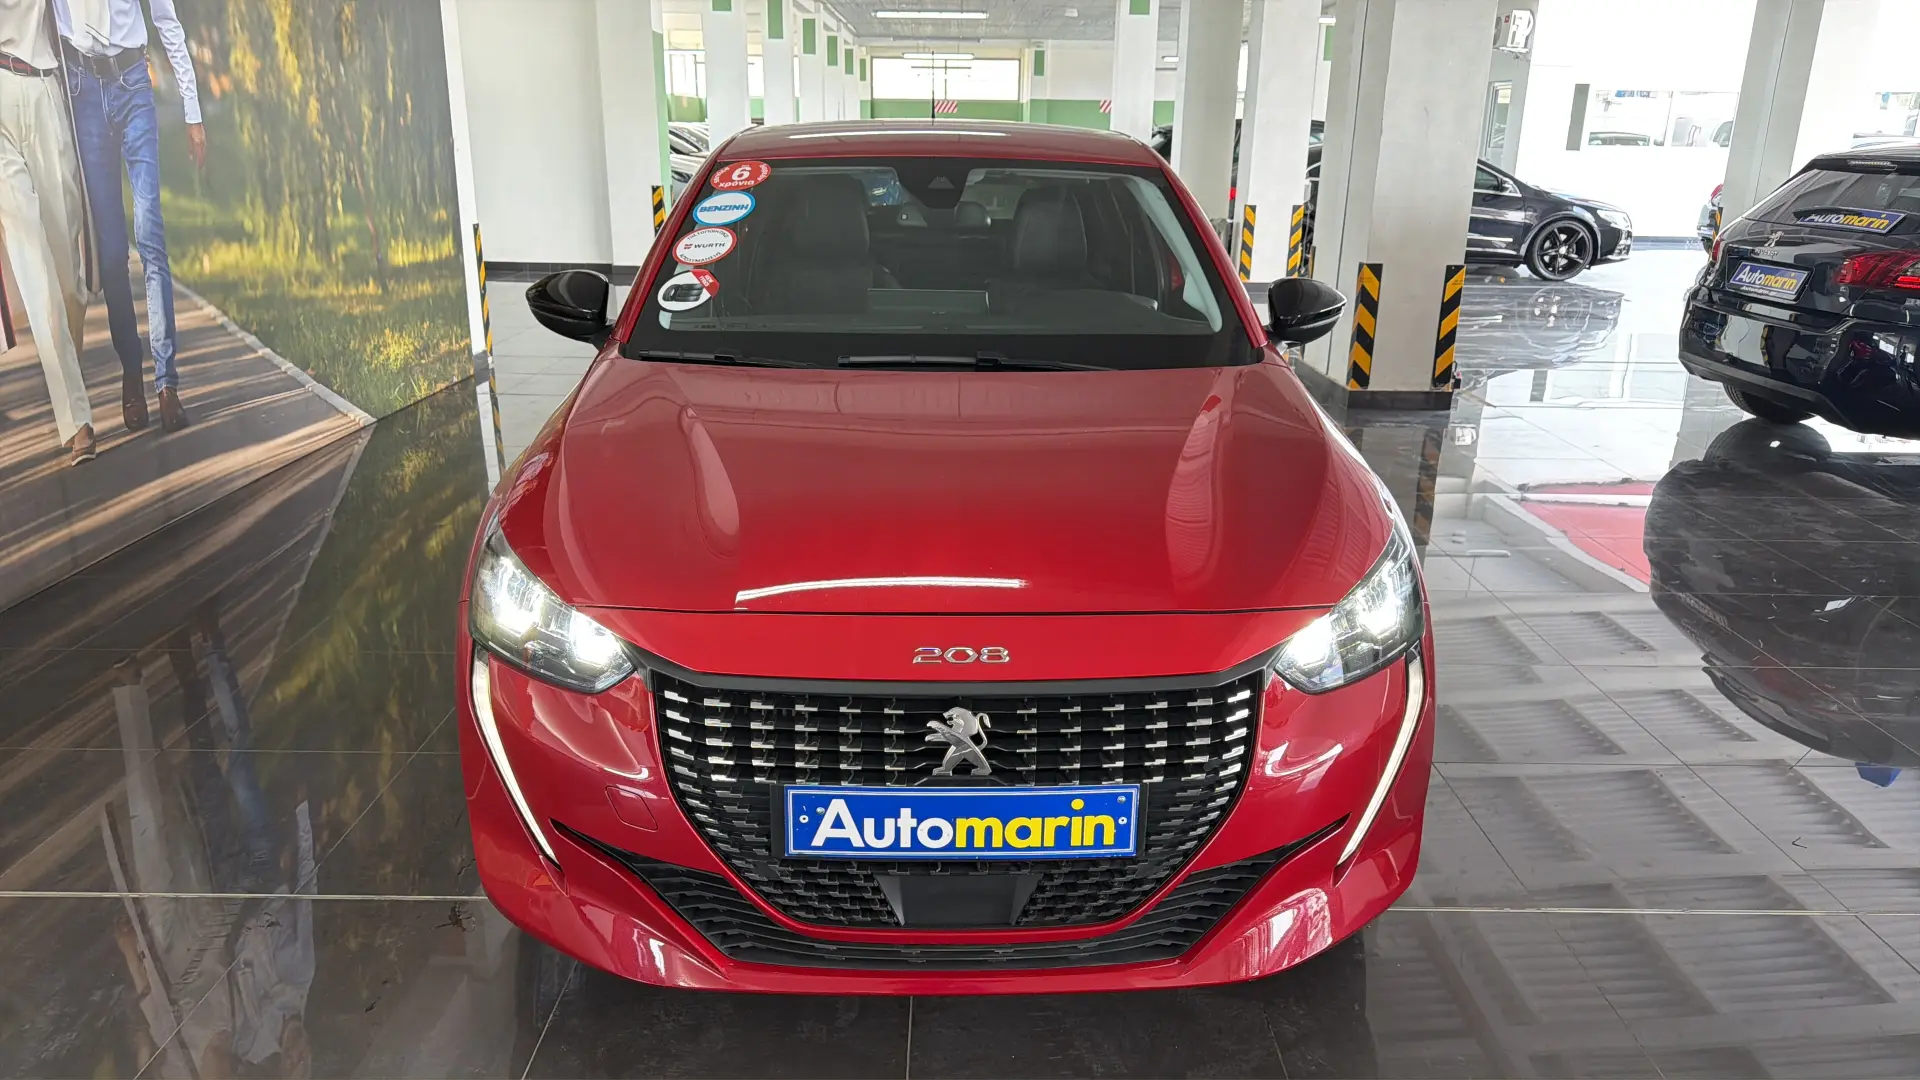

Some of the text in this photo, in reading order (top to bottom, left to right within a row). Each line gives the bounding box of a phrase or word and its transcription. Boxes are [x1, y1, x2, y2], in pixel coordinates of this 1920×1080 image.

[731, 166, 752, 181] 6
[718, 180, 755, 189] χρόνια
[1734, 264, 1798, 291] Automarin
[912, 646, 1011, 665] 208
[810, 798, 1116, 849] Automarin
